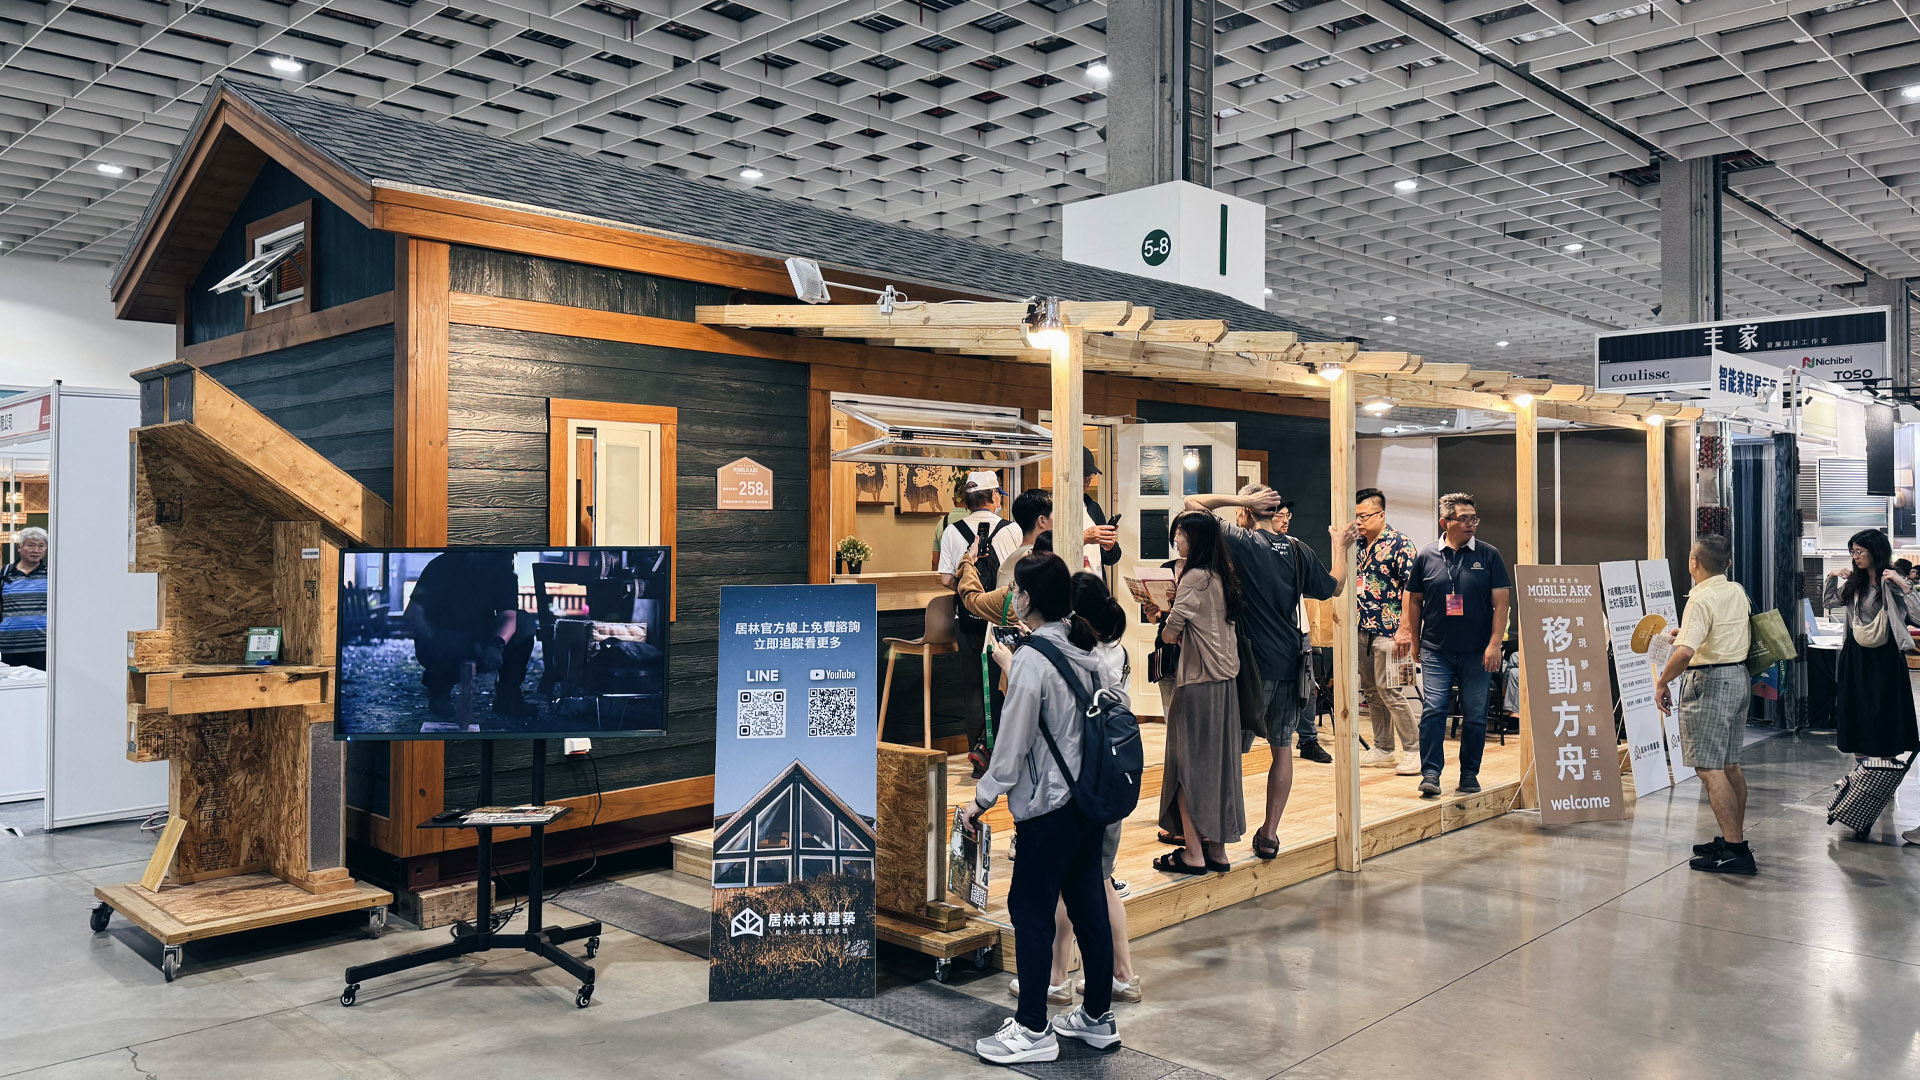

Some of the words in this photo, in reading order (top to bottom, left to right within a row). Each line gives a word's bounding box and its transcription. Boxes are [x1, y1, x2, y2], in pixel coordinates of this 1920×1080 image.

[1144, 237, 1169, 257] 5-8
[1815, 356, 1853, 366] Nichibei
[1611, 369, 1670, 383] coulisse
[1834, 369, 1873, 380] TOSO
[739, 481, 764, 496] 258
[1527, 584, 1567, 597] MOBILE
[1569, 584, 1593, 597] ARK
[735, 621, 860, 635] 居林官方線上免費諮詢
[754, 636, 842, 650] 立即追蹤看更多
[746, 669, 779, 682] LINE
[826, 669, 856, 680] YouTube
[1542, 616, 1587, 782] 移動方舟
[1575, 616, 1602, 782] 實現夢想木屋生活
[1551, 795, 1611, 811] welcome
[768, 912, 855, 927] 居林木構建築
